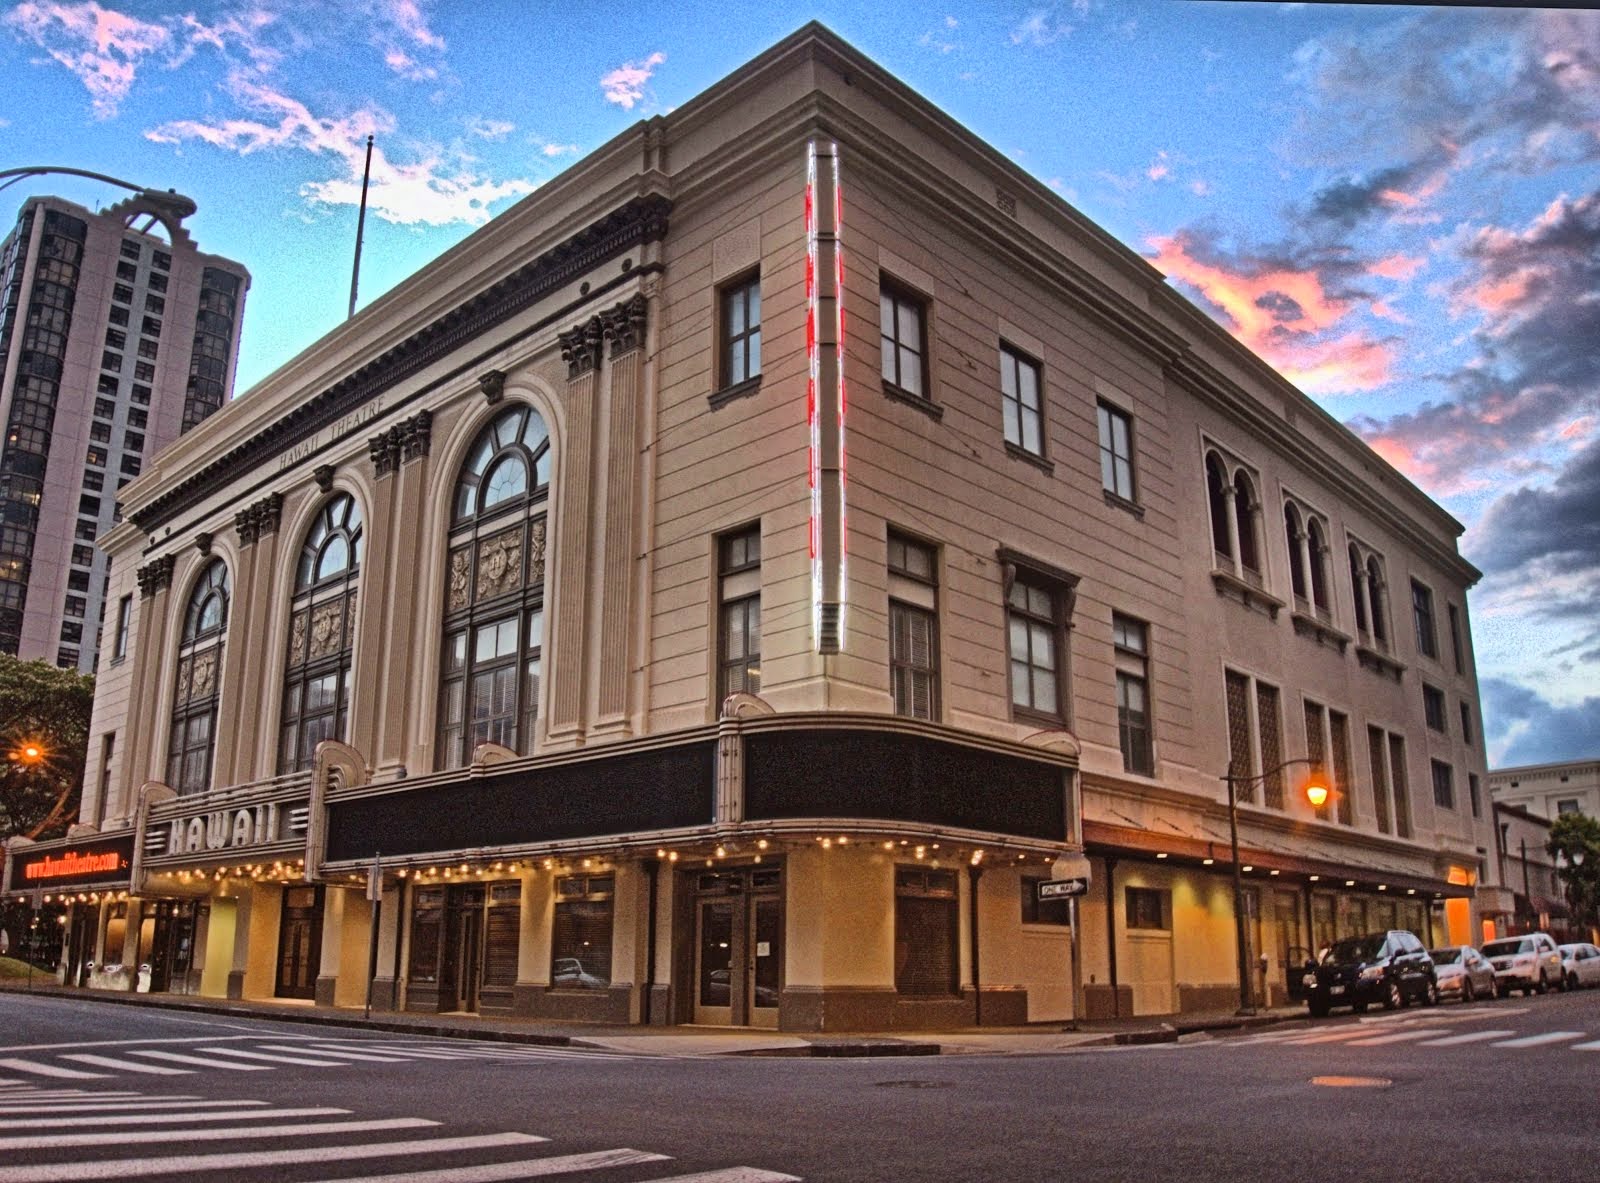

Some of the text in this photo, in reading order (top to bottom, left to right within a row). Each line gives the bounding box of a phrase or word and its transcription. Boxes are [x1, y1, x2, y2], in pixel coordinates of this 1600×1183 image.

[280, 395, 386, 470] HAWAII THEATRE
[168, 803, 280, 855] HAWAII
[26, 852, 119, 879] www.hawaiitheatre.com
[1043, 884, 1073, 895] ONE WAY
